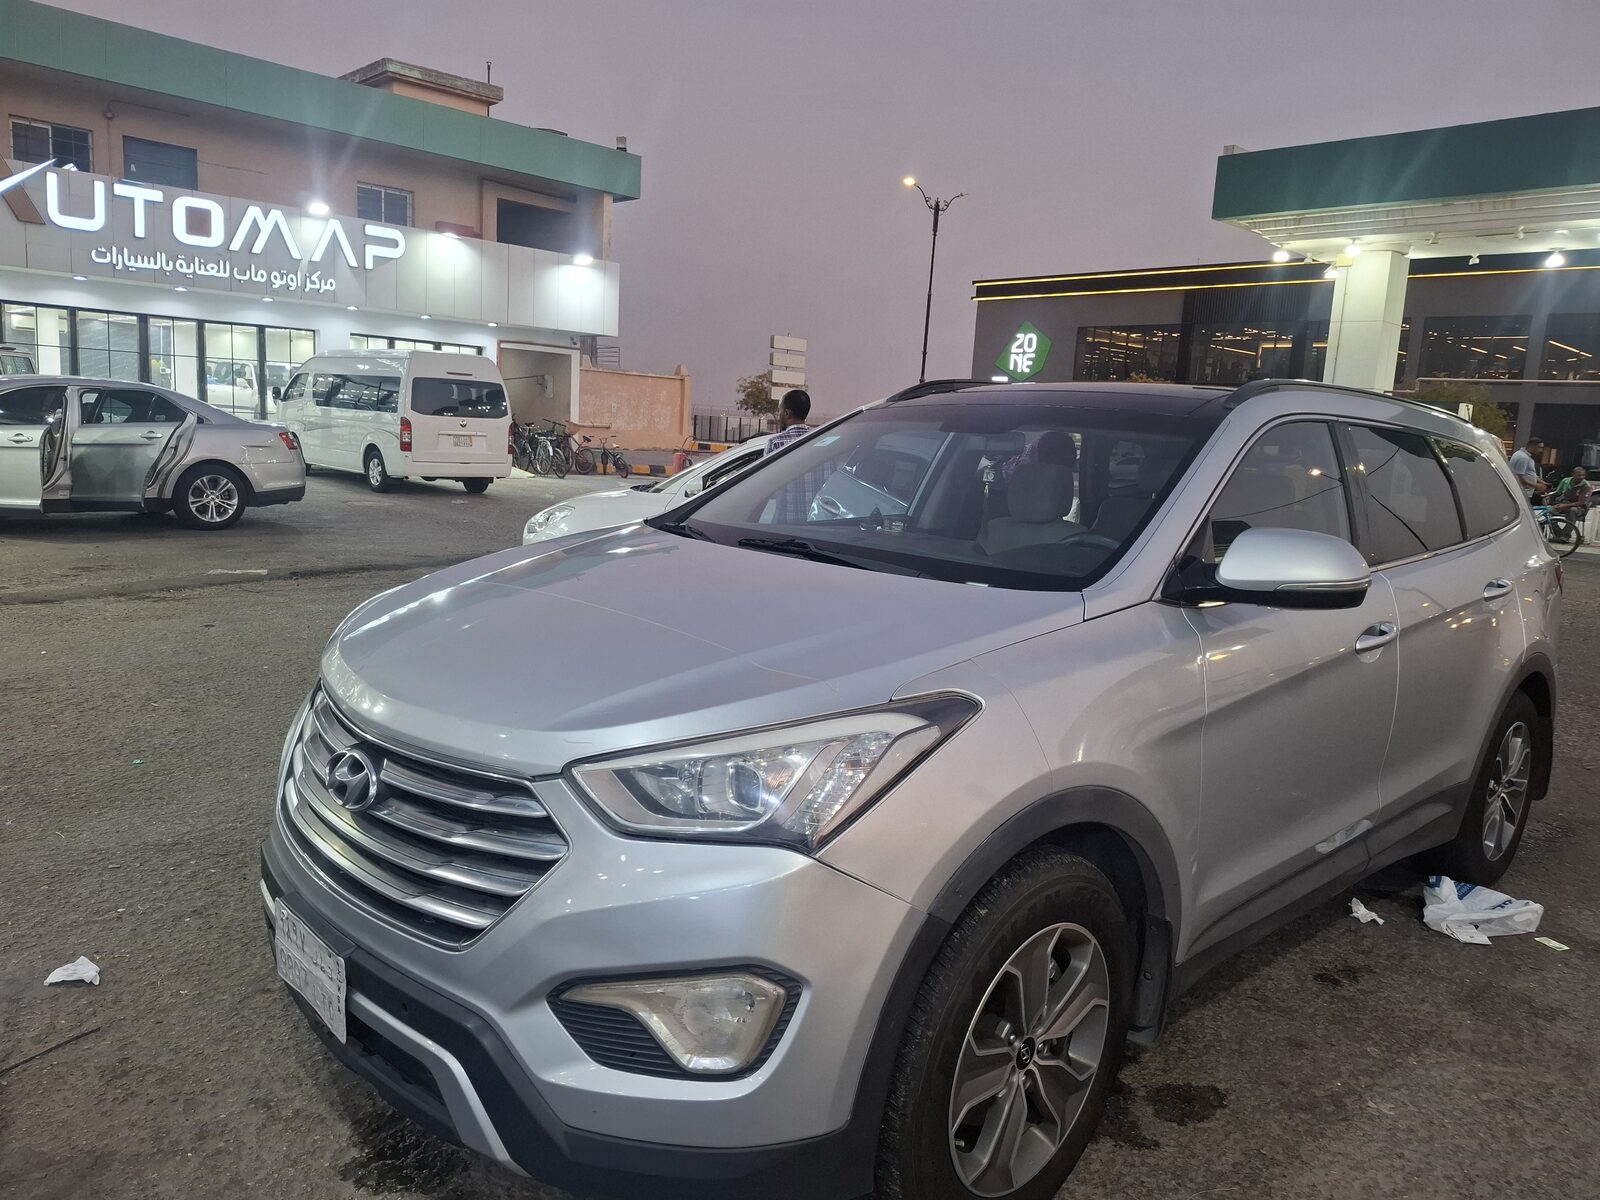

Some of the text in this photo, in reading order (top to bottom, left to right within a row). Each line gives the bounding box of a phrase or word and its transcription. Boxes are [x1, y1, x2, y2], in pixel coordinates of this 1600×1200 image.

[90, 245, 337, 293] مركز اوتو ماب للعناية بالسيارات
